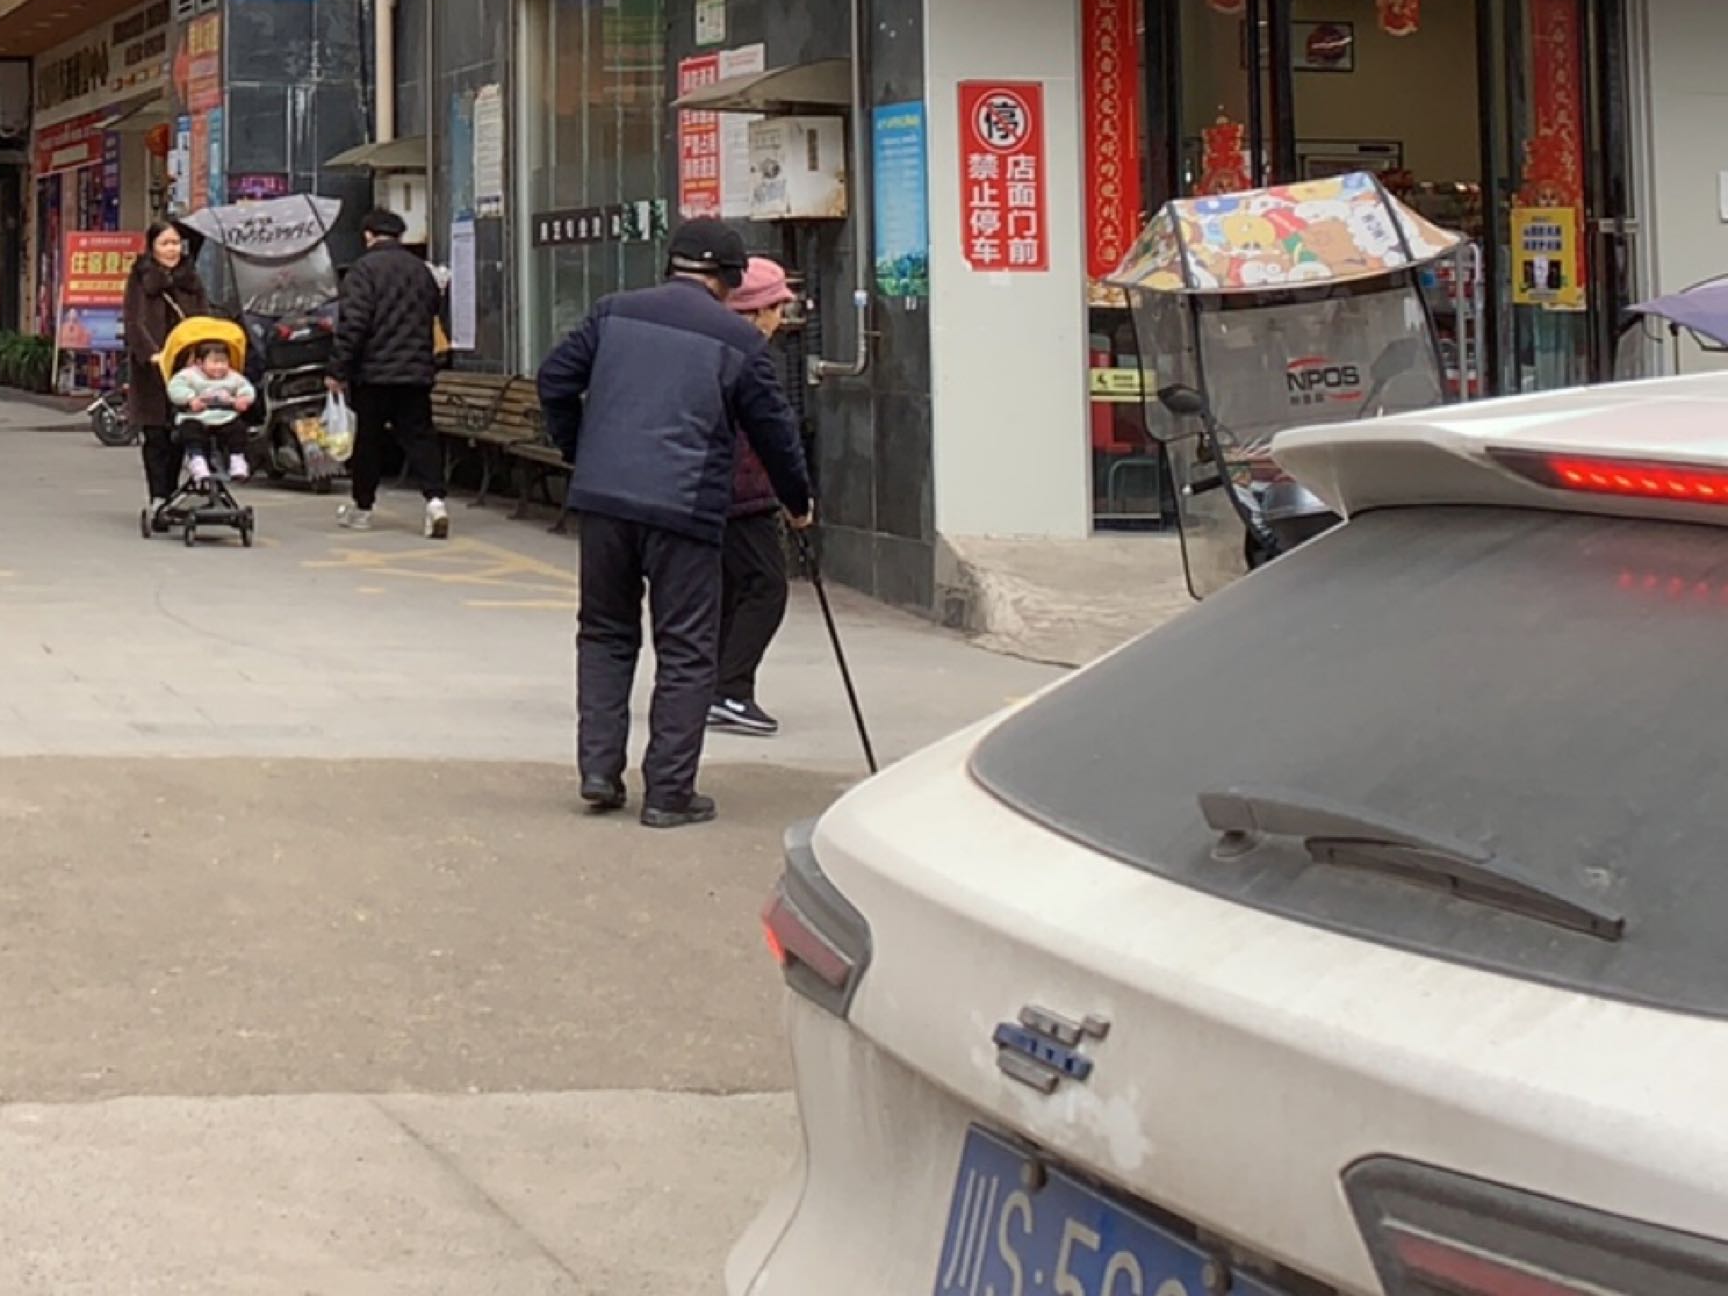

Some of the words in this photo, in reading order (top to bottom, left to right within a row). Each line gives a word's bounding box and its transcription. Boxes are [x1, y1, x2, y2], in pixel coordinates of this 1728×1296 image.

[969, 153, 1002, 265] 禁止停车
[1006, 153, 1038, 265] 店面门前
